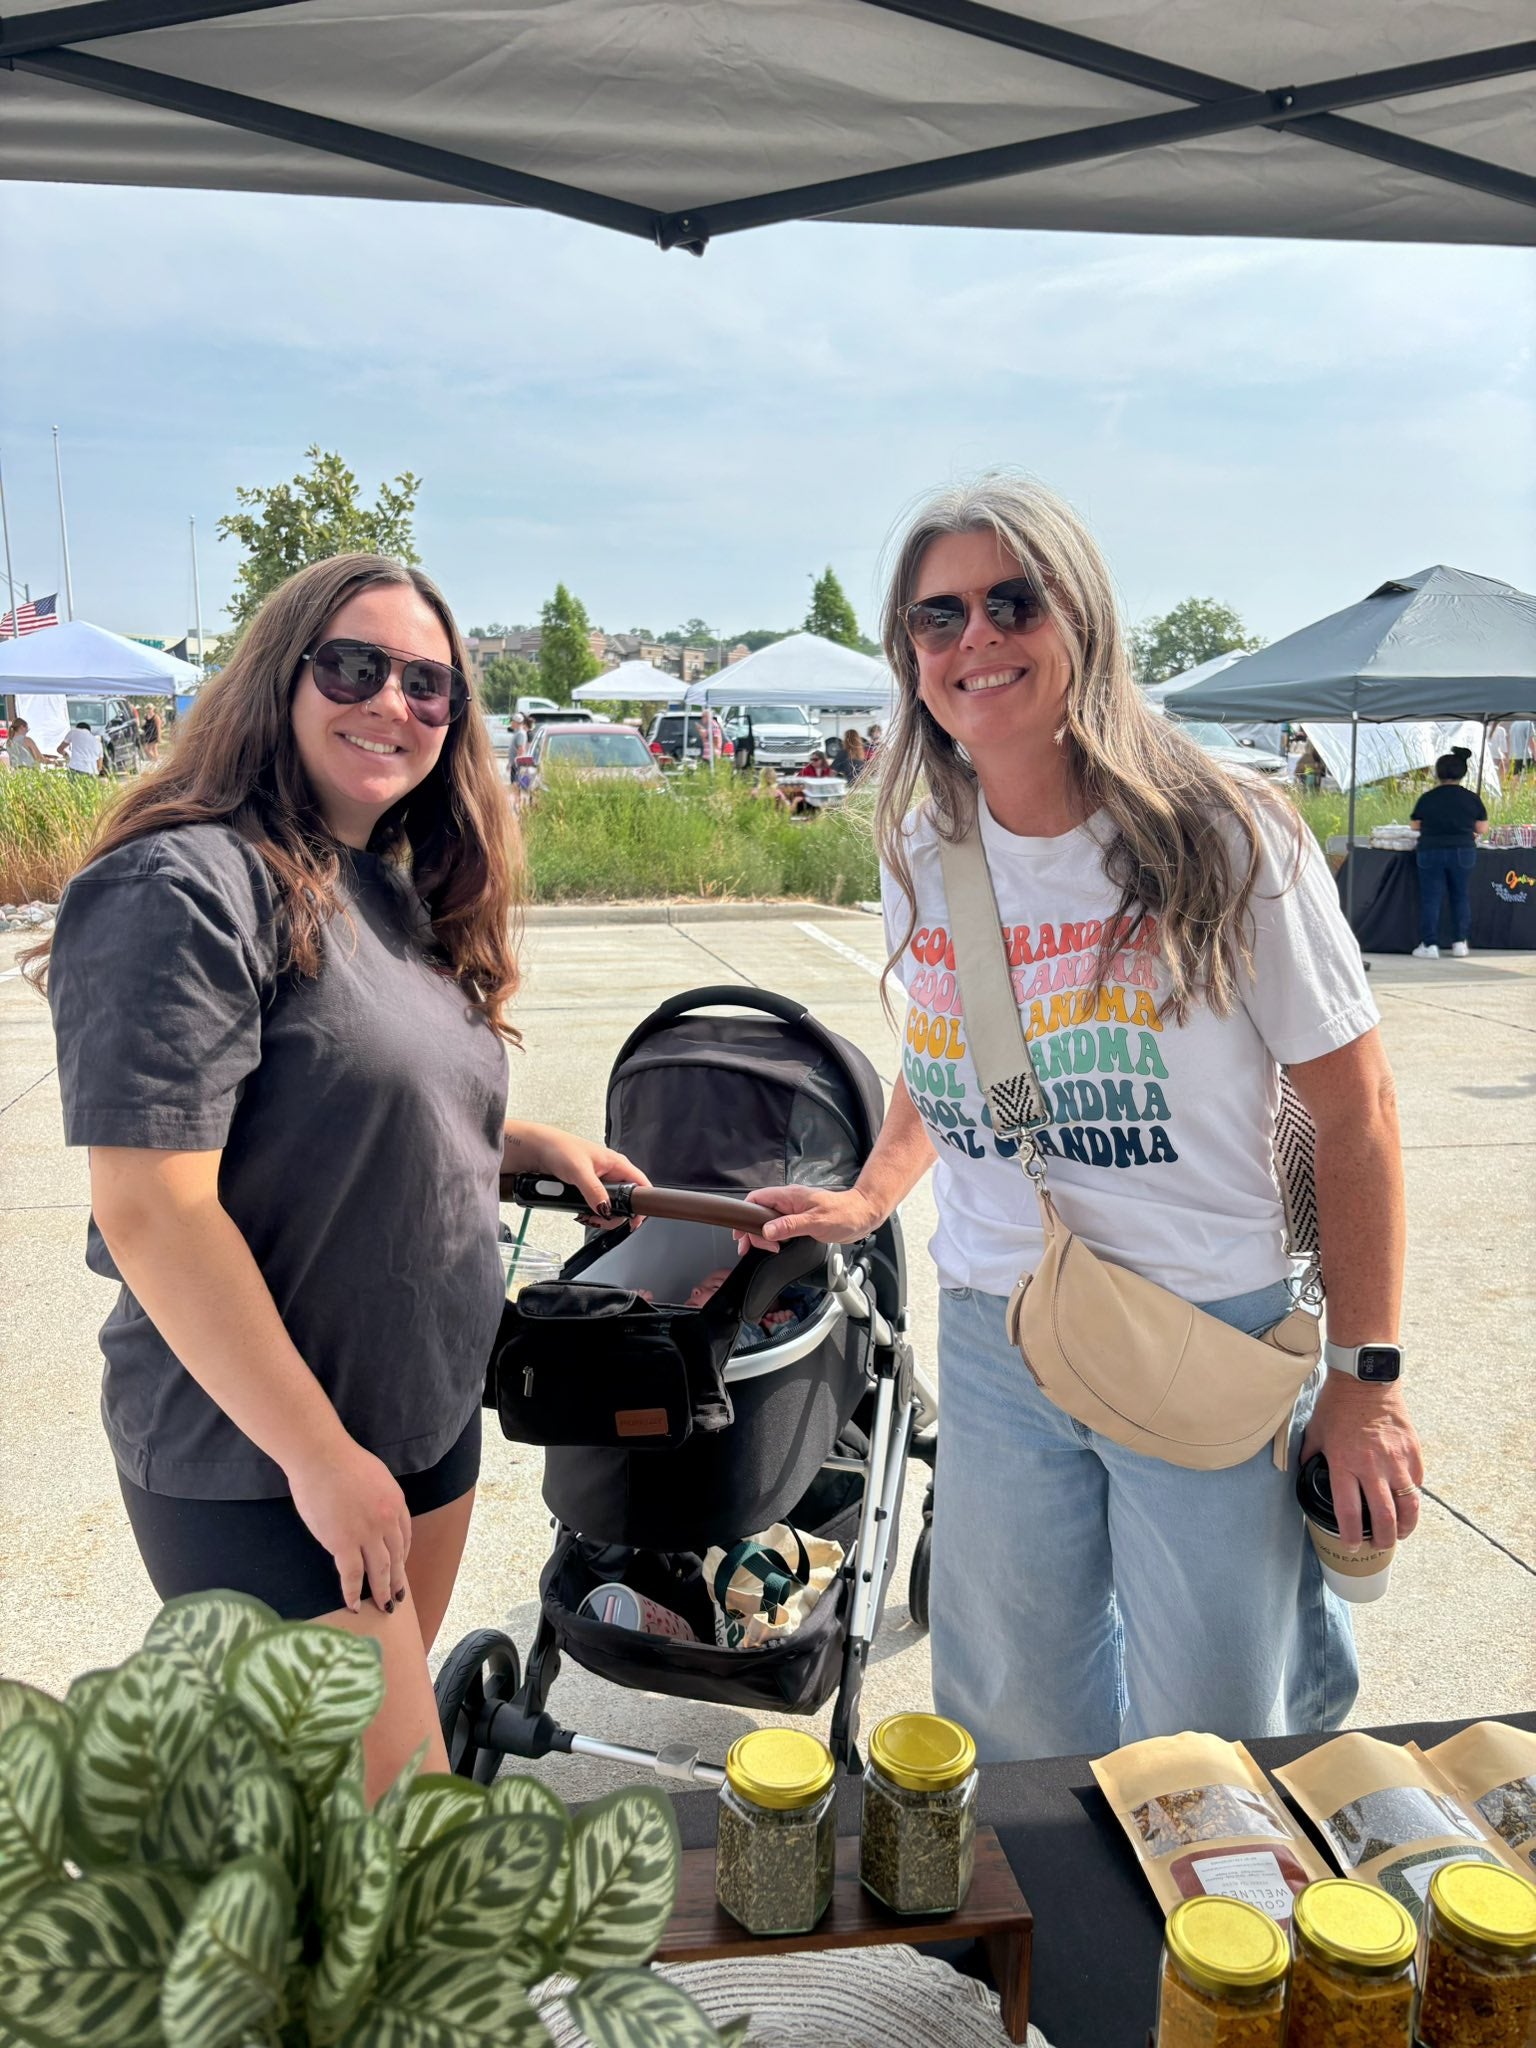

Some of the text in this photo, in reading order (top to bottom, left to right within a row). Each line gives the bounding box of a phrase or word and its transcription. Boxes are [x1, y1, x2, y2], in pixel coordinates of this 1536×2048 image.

[910, 927, 956, 970] CO
[1009, 951, 1158, 1004] RANDMA
[906, 985, 1164, 1059] COOL ANDMA
[904, 1026, 1169, 1098] COOL ANDMA
[910, 1079, 1172, 1129] COOL NDMA
[994, 1125, 1179, 1168] GANDMA
[1213, 1888, 1288, 1899] WELLNE
